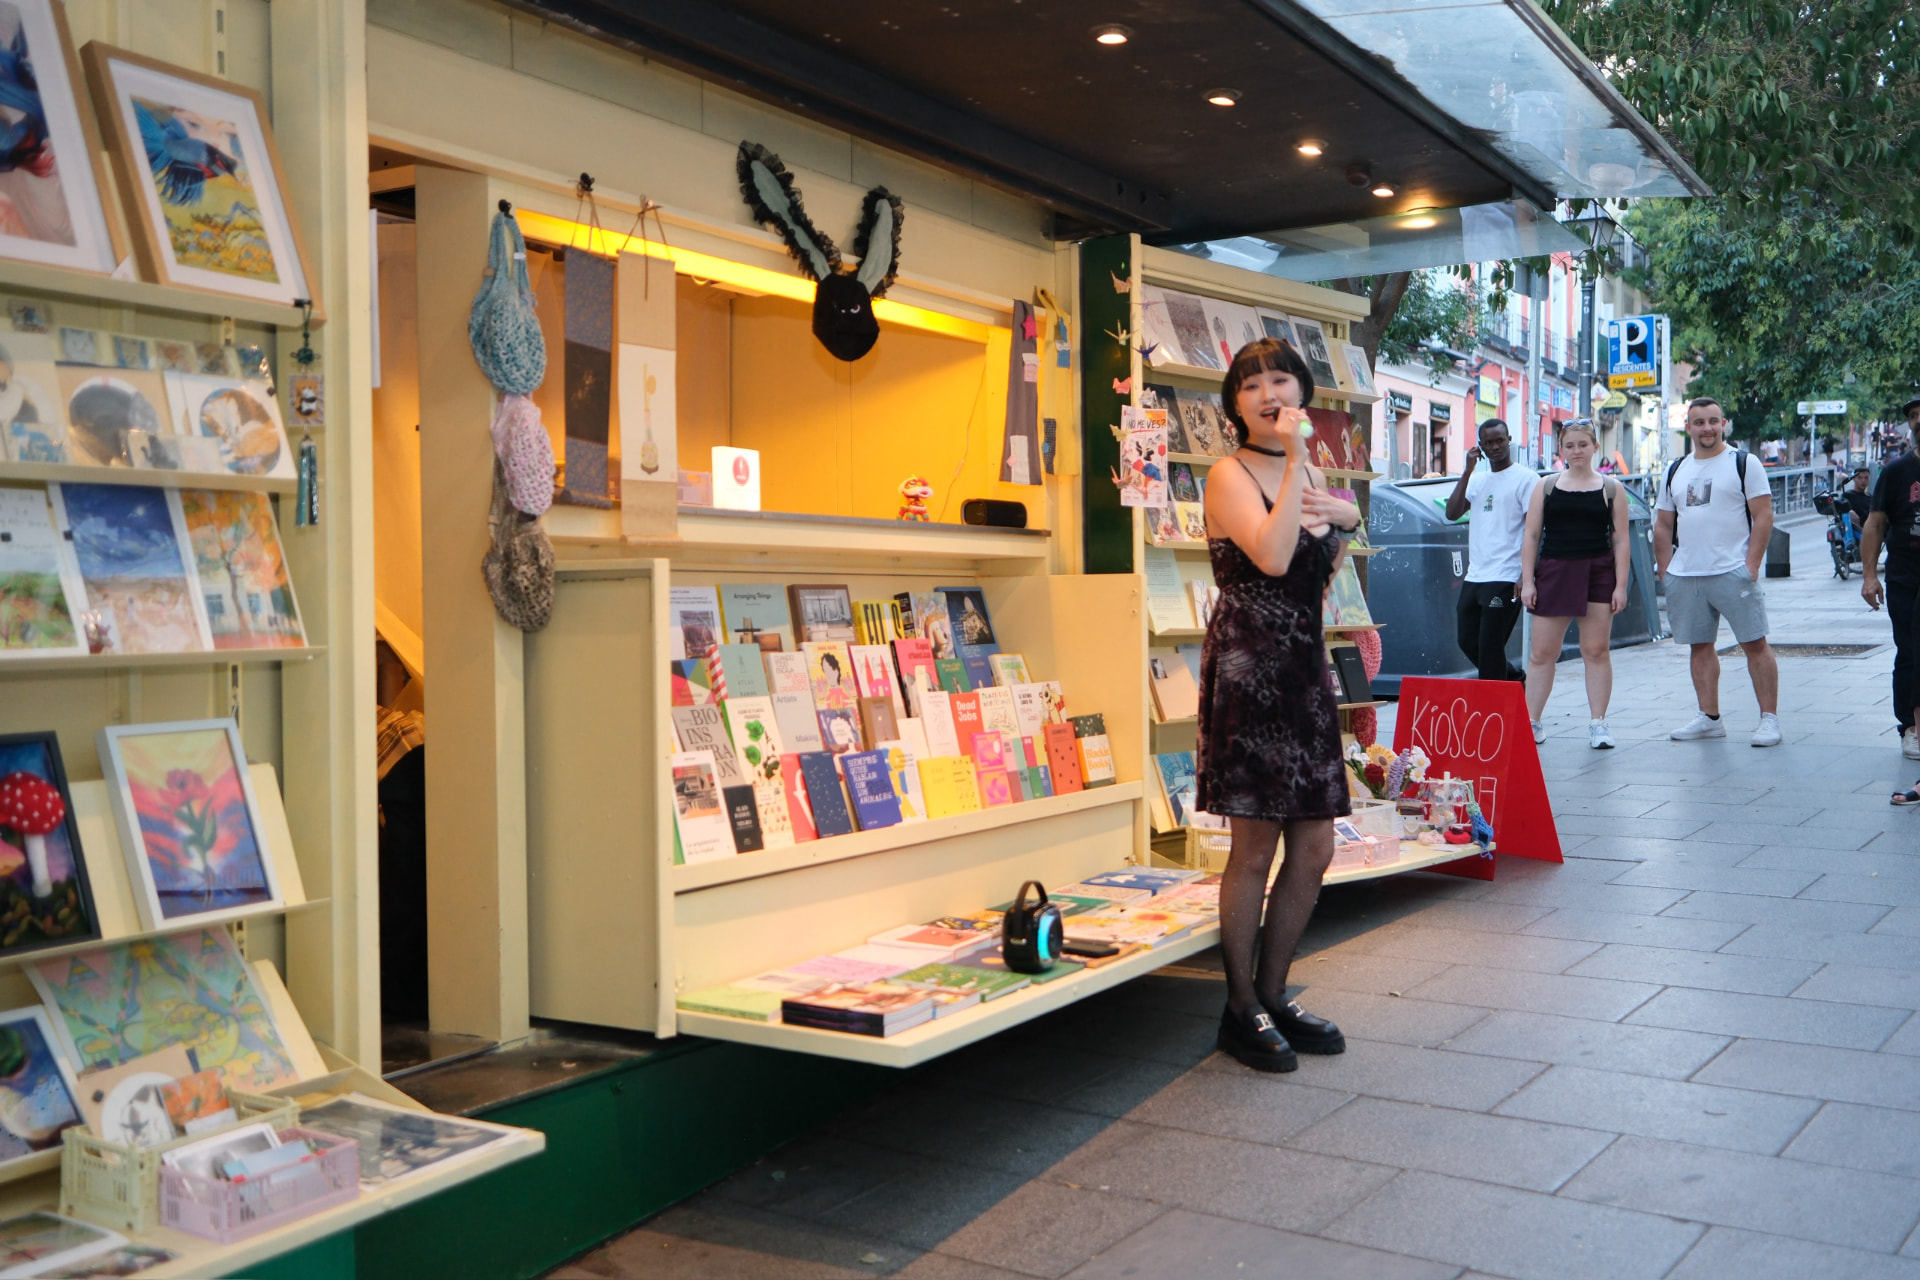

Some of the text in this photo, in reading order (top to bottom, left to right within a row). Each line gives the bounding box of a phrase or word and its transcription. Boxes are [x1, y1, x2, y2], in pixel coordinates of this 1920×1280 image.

[1614, 319, 1648, 365] P
[1613, 362, 1651, 373] RESIDENTES
[1137, 418, 1145, 429] ME
[1146, 418, 1166, 429] VES?
[733, 592, 756, 600] Arranging
[776, 695, 797, 703] Artists
[956, 700, 976, 711] Dead
[690, 708, 718, 726] BIO
[958, 711, 977, 722] Jobs
[685, 727, 713, 745] INS
[795, 735, 819, 743] Making
[1085, 747, 1110, 759] Blackie
[1088, 759, 1109, 770] Books
[860, 792, 893, 804] ANIMALES
